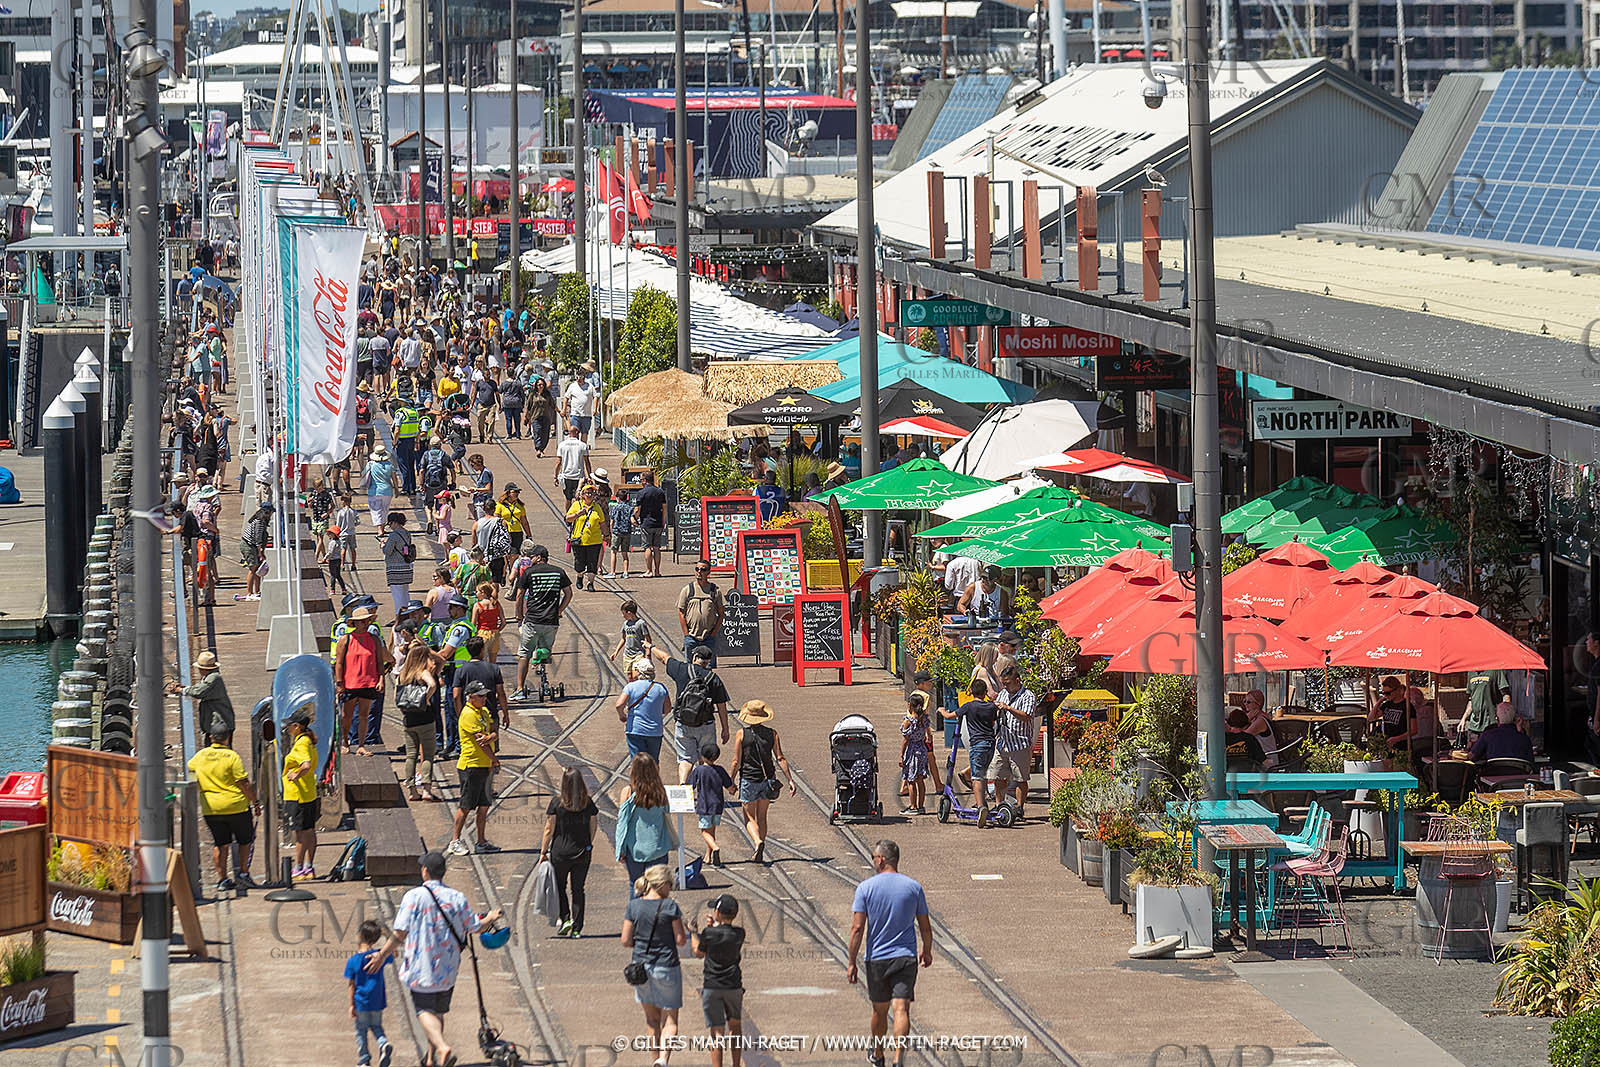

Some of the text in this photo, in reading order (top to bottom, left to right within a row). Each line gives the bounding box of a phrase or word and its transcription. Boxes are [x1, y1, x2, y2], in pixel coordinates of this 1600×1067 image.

[933, 305, 979, 313] GOODLUCK
[314, 265, 349, 416] Coca-Cola
[1005, 334, 1114, 350] Moshi Moshi
[1270, 411, 1400, 430] NORTH PARK
[51, 891, 96, 926] Coca-Cola
[1, 987, 49, 1032] Coca-Cola
